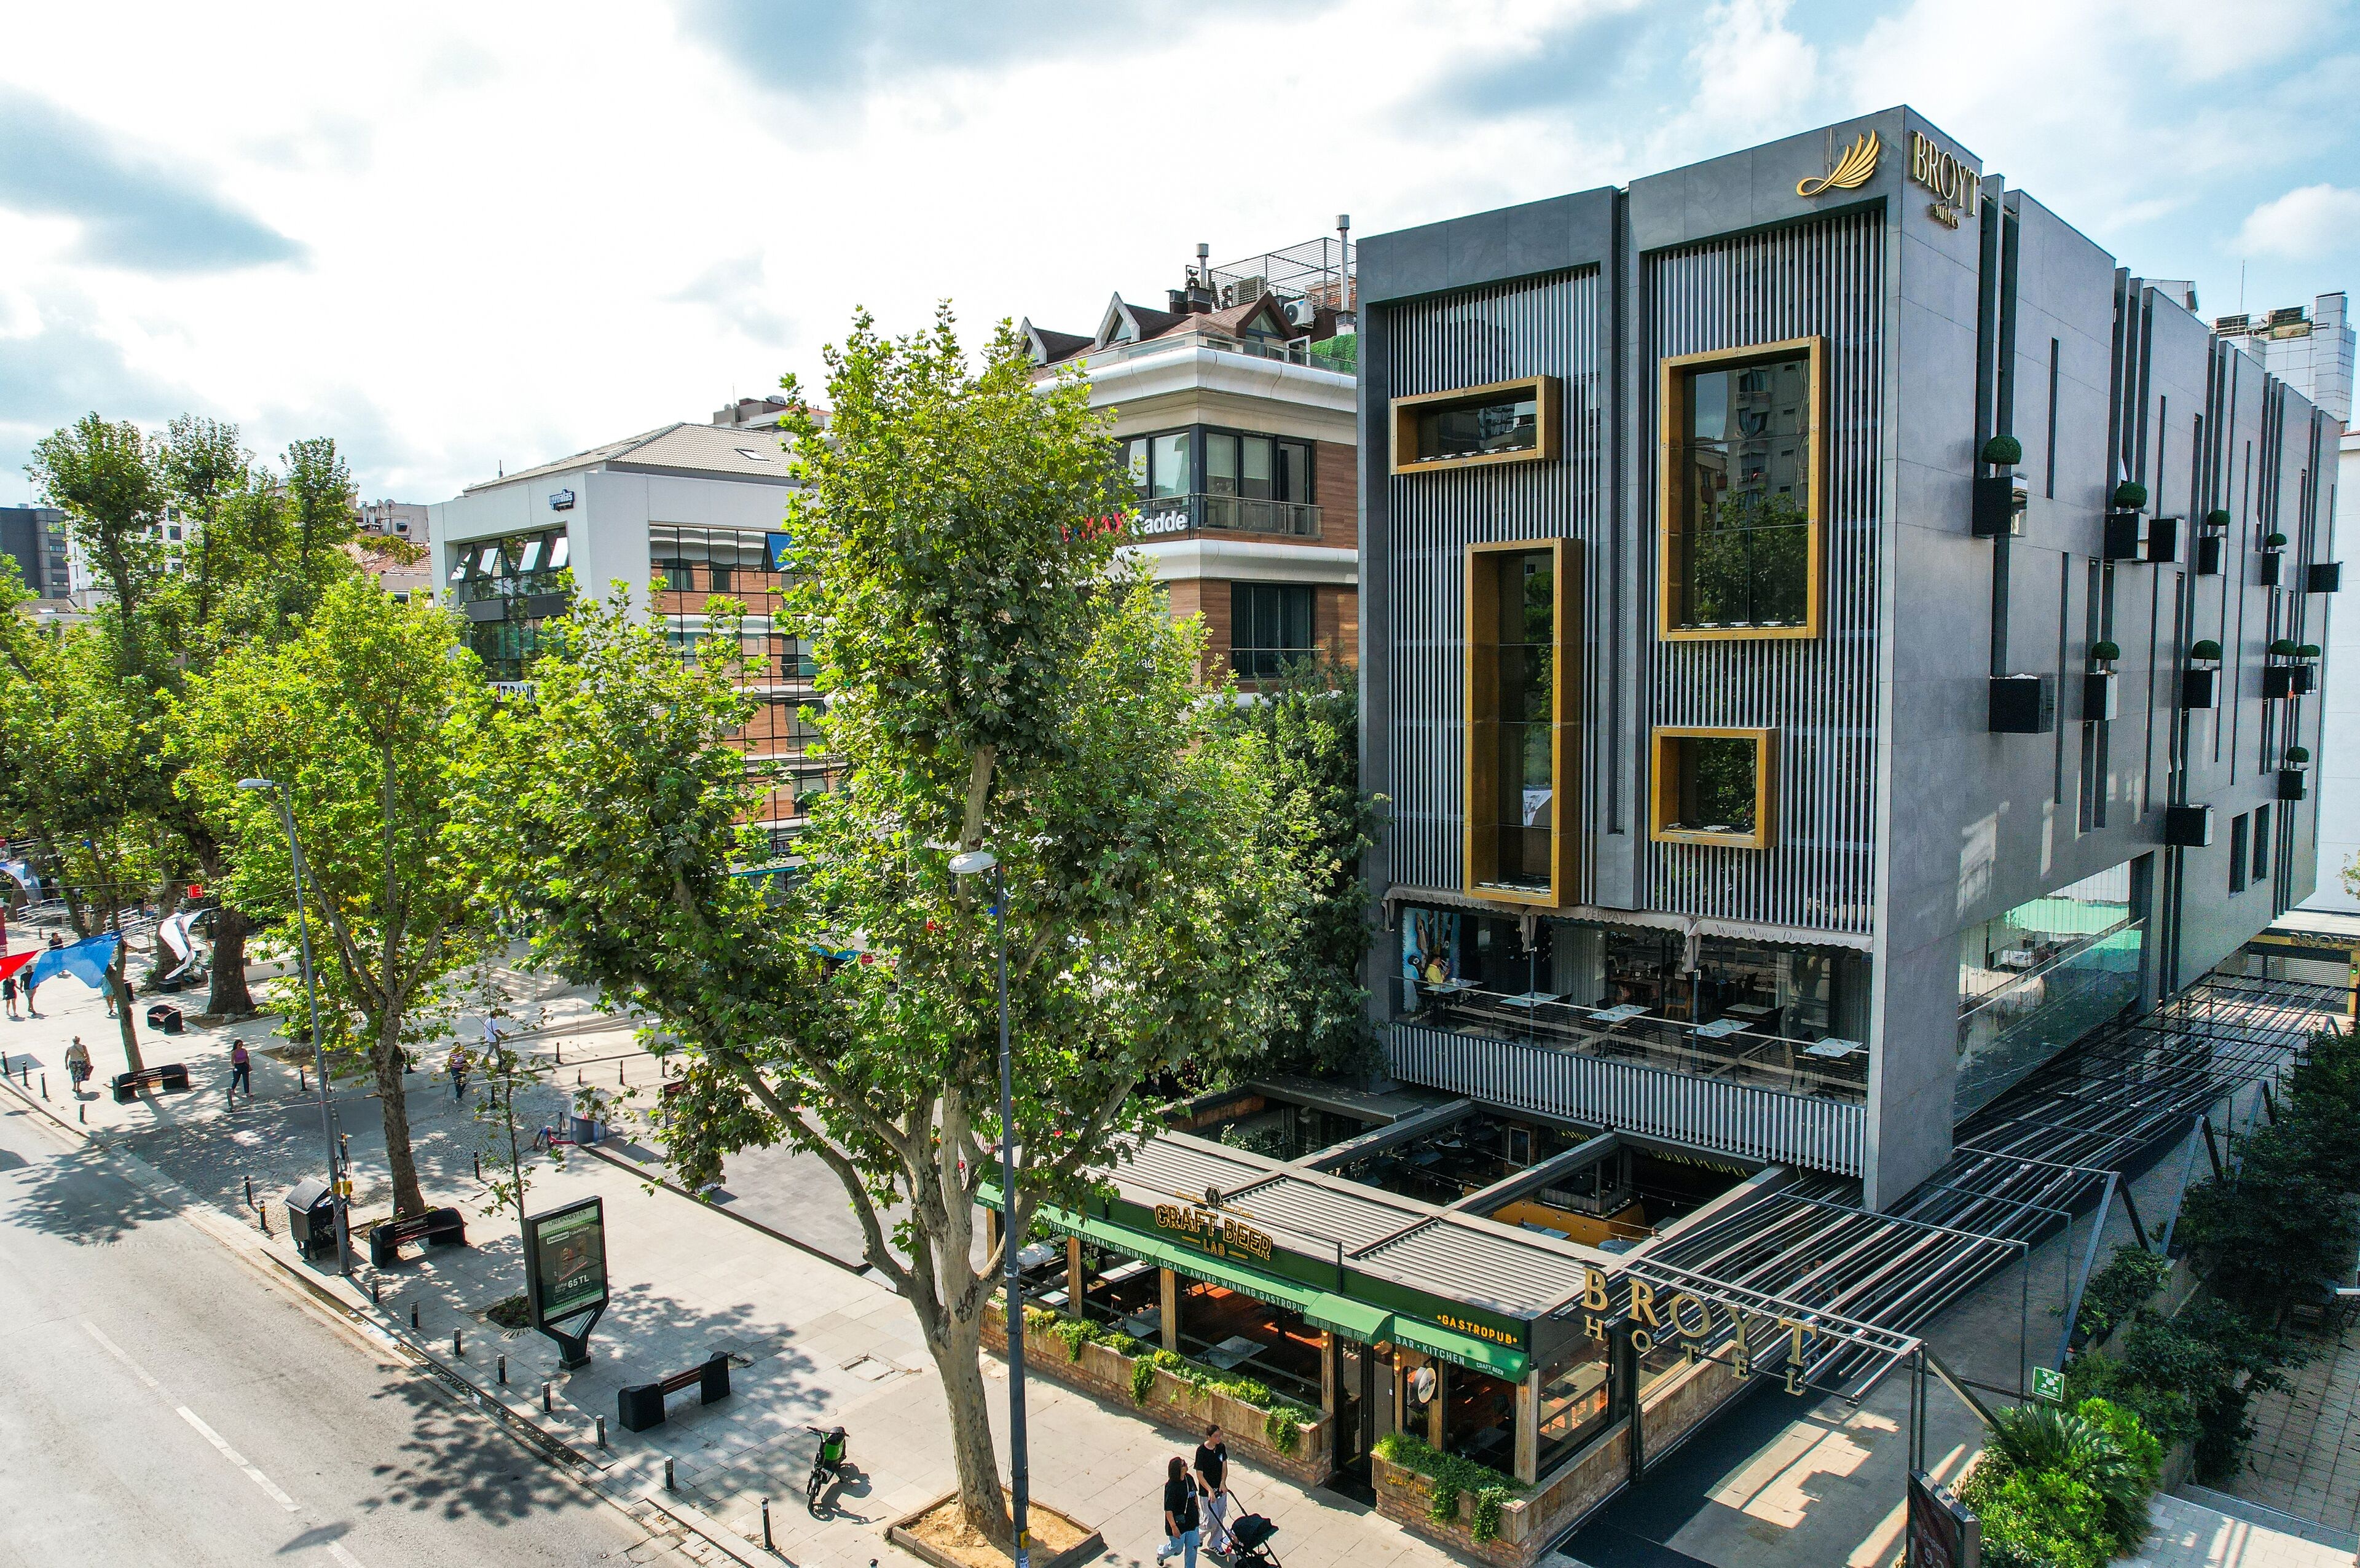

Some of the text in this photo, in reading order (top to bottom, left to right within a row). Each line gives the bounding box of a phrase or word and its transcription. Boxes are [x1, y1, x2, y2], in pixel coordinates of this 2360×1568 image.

[1913, 130, 1981, 217] BROYT
[1934, 203, 1961, 230] suites
[1130, 511, 1189, 536] Cadde
[1715, 923, 1853, 945] Wine Music Delicatessen
[1071, 1229, 1110, 1249] ARTISANAL
[1115, 1244, 1148, 1262] ORIGINAL
[1155, 1203, 1273, 1261] CRAFT BEER
[1203, 1239, 1225, 1256] LAB
[1158, 1258, 1183, 1273] LOCAL
[1190, 1269, 1256, 1297] AWARD-WINNING
[1305, 1315, 1318, 1327] GOOD
[1319, 1317, 1331, 1331] BEER
[1340, 1326, 1353, 1338] GOOD
[1354, 1330, 1371, 1344] PEOPLE
[1580, 1266, 1818, 1366] BROYT
[1396, 1335, 1465, 1365] BAR KITCHEN
[1584, 1314, 1807, 1397] HOTEL
[1476, 1362, 1504, 1376] CRAFT BEER
